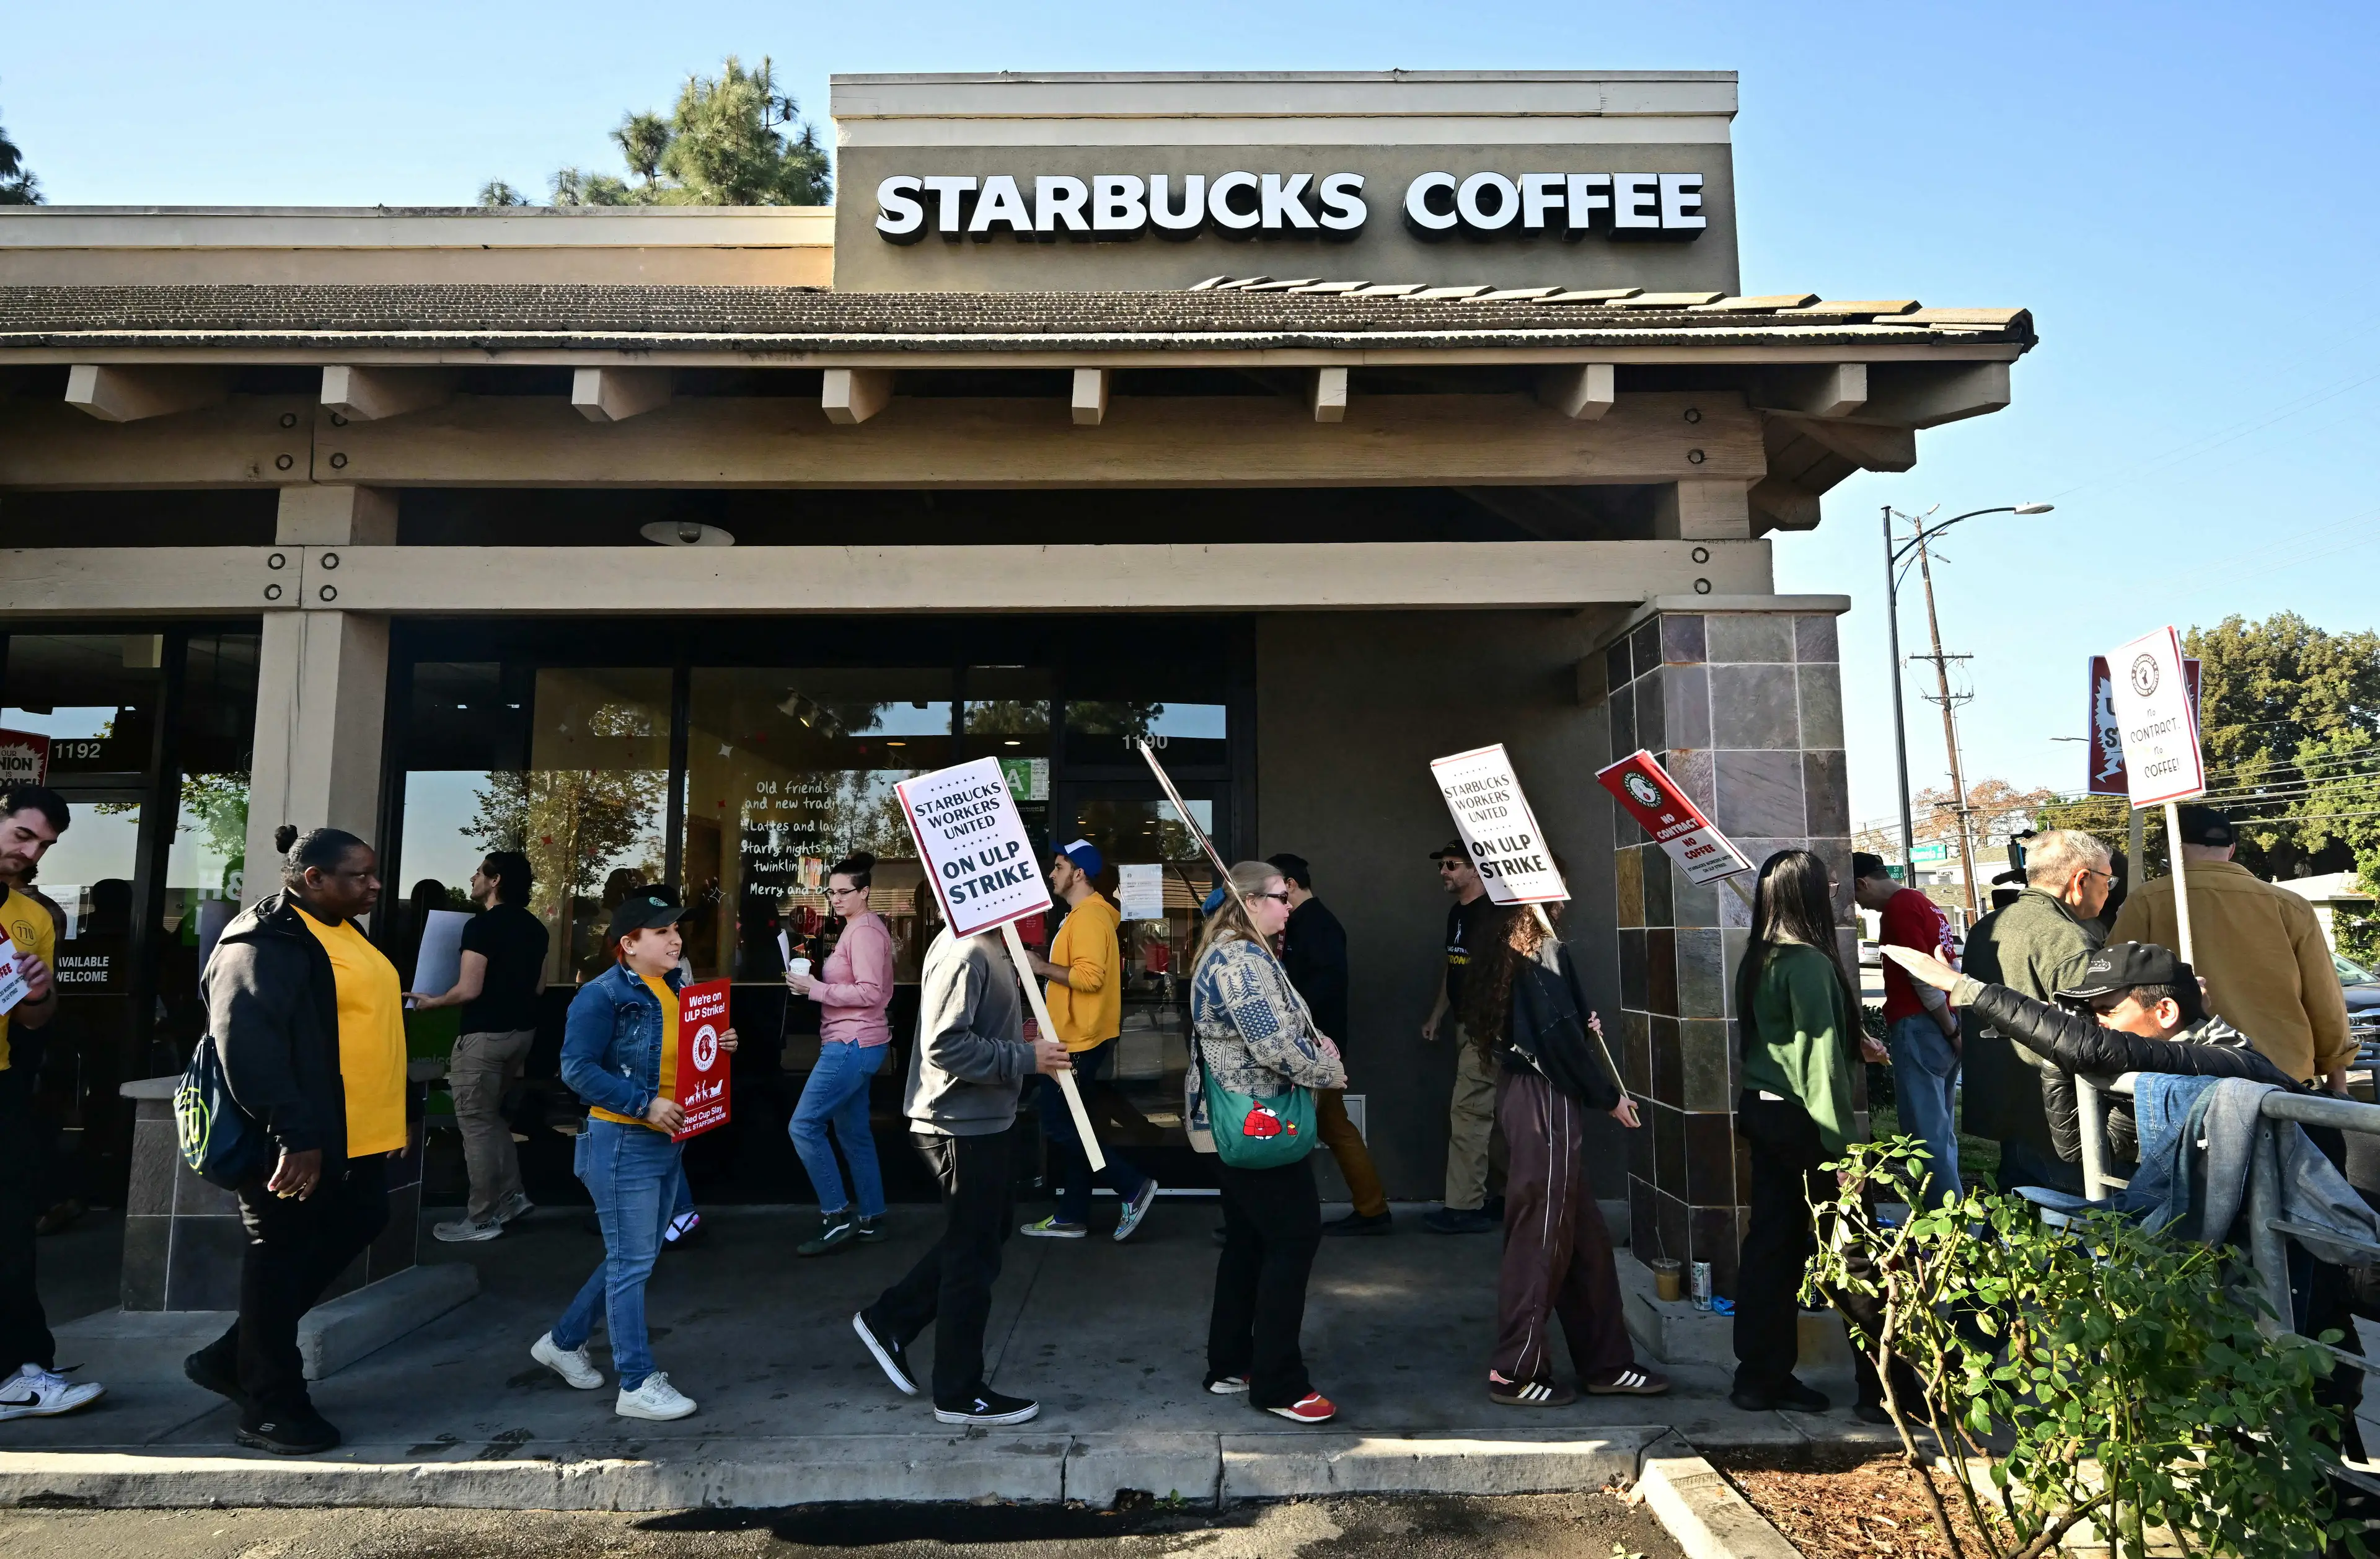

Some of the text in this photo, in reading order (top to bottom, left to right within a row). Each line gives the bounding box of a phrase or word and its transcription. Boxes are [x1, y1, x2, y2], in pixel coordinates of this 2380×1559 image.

[875, 170, 1707, 238] STARBUCKS COFFEE
[2130, 717, 2180, 743] CONTRACT.
[1122, 734, 1168, 749] 1190
[55, 743, 101, 759] 1192
[0, 757, 33, 771] NION
[2144, 757, 2180, 778] COFFEE!
[756, 780, 829, 795] Old friends
[1007, 769, 1024, 792] A
[1444, 774, 1510, 798] STARBUCKS
[746, 797, 768, 810] and
[775, 798, 798, 810] new
[915, 782, 1002, 816] STARBUCKS
[1455, 790, 1510, 810] WORKERS
[927, 798, 1000, 829] WORKERS
[1468, 806, 1507, 823] UNITED
[1660, 813, 1675, 824] NO
[750, 819, 790, 832] Lattes
[793, 819, 815, 832] and
[943, 815, 995, 839] UNITED
[1657, 818, 1699, 839] CONTRACT
[740, 839, 848, 857] Starry nights and
[1471, 834, 1531, 857] ON ULP
[1681, 837, 1697, 847] NO
[943, 841, 1020, 879] ON ULP
[1685, 844, 1716, 859] COFFEE
[754, 859, 804, 875] twinklin
[1479, 855, 1547, 879] STRIKE
[1688, 862, 1706, 872] STARBUCKS
[198, 868, 244, 901] H&
[750, 882, 784, 896] Merry
[788, 883, 808, 895] and
[948, 860, 1034, 904] STRIKE
[17, 926, 33, 940] 770
[0, 962, 12, 980] FEE
[56, 971, 108, 981] WELCOME
[2071, 986, 2107, 994] FRANCISCO
[689, 992, 721, 1008] We're on
[684, 1002, 725, 1023] ULP Strike!
[684, 1105, 723, 1124] Red Cup Slay
[692, 1116, 715, 1131] STAFFING
[715, 1112, 726, 1121] NOW
